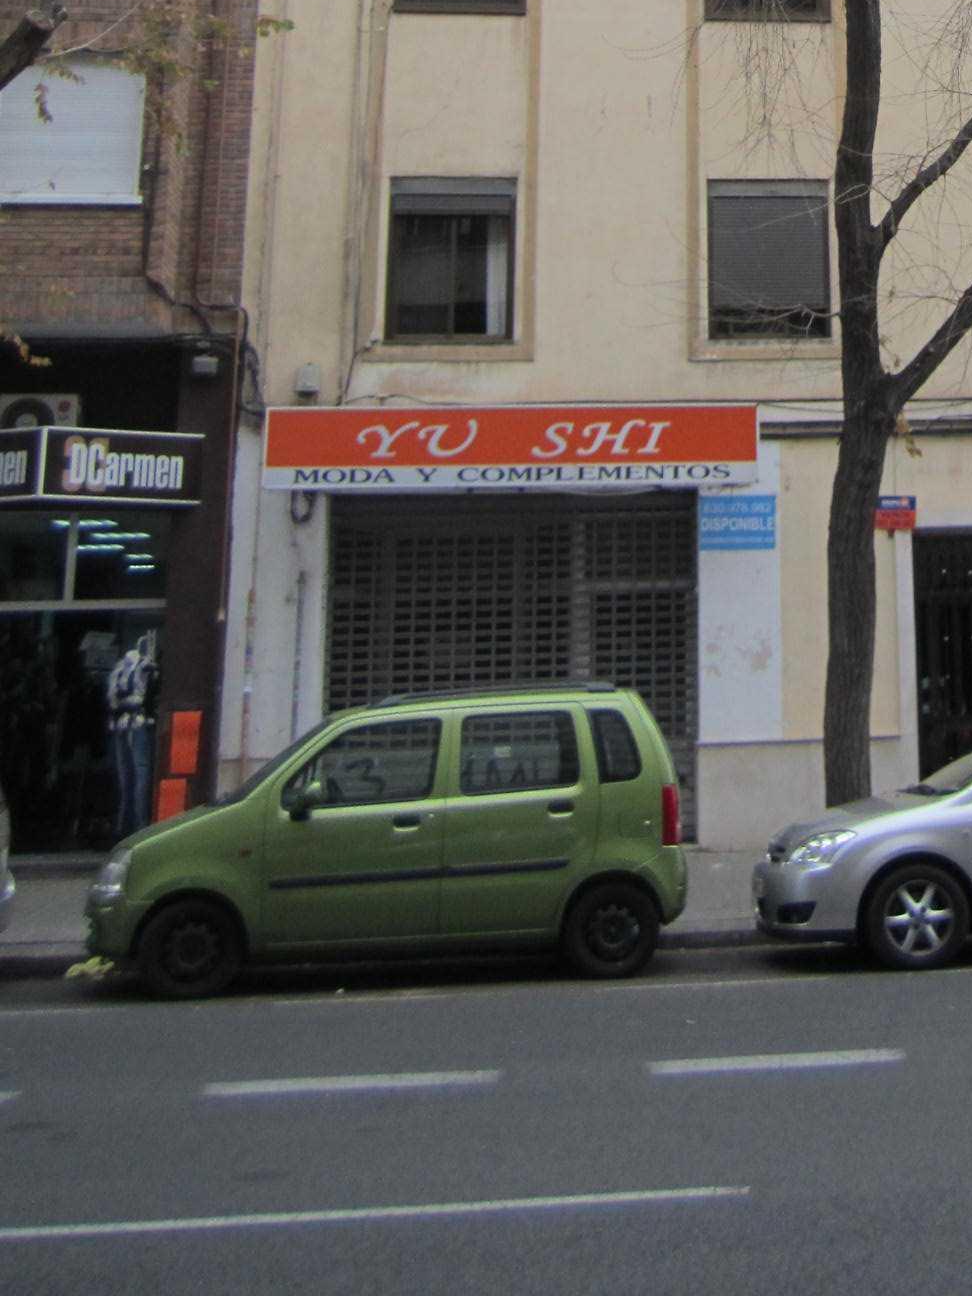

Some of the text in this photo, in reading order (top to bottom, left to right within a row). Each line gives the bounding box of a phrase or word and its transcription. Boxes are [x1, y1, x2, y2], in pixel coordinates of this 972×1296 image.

[356, 419, 672, 458] YU SHI
[69, 442, 184, 489] DCarmen
[293, 464, 730, 484] MODA Y COMPLEMENTOS
[701, 516, 776, 531] DISPONIBLE
